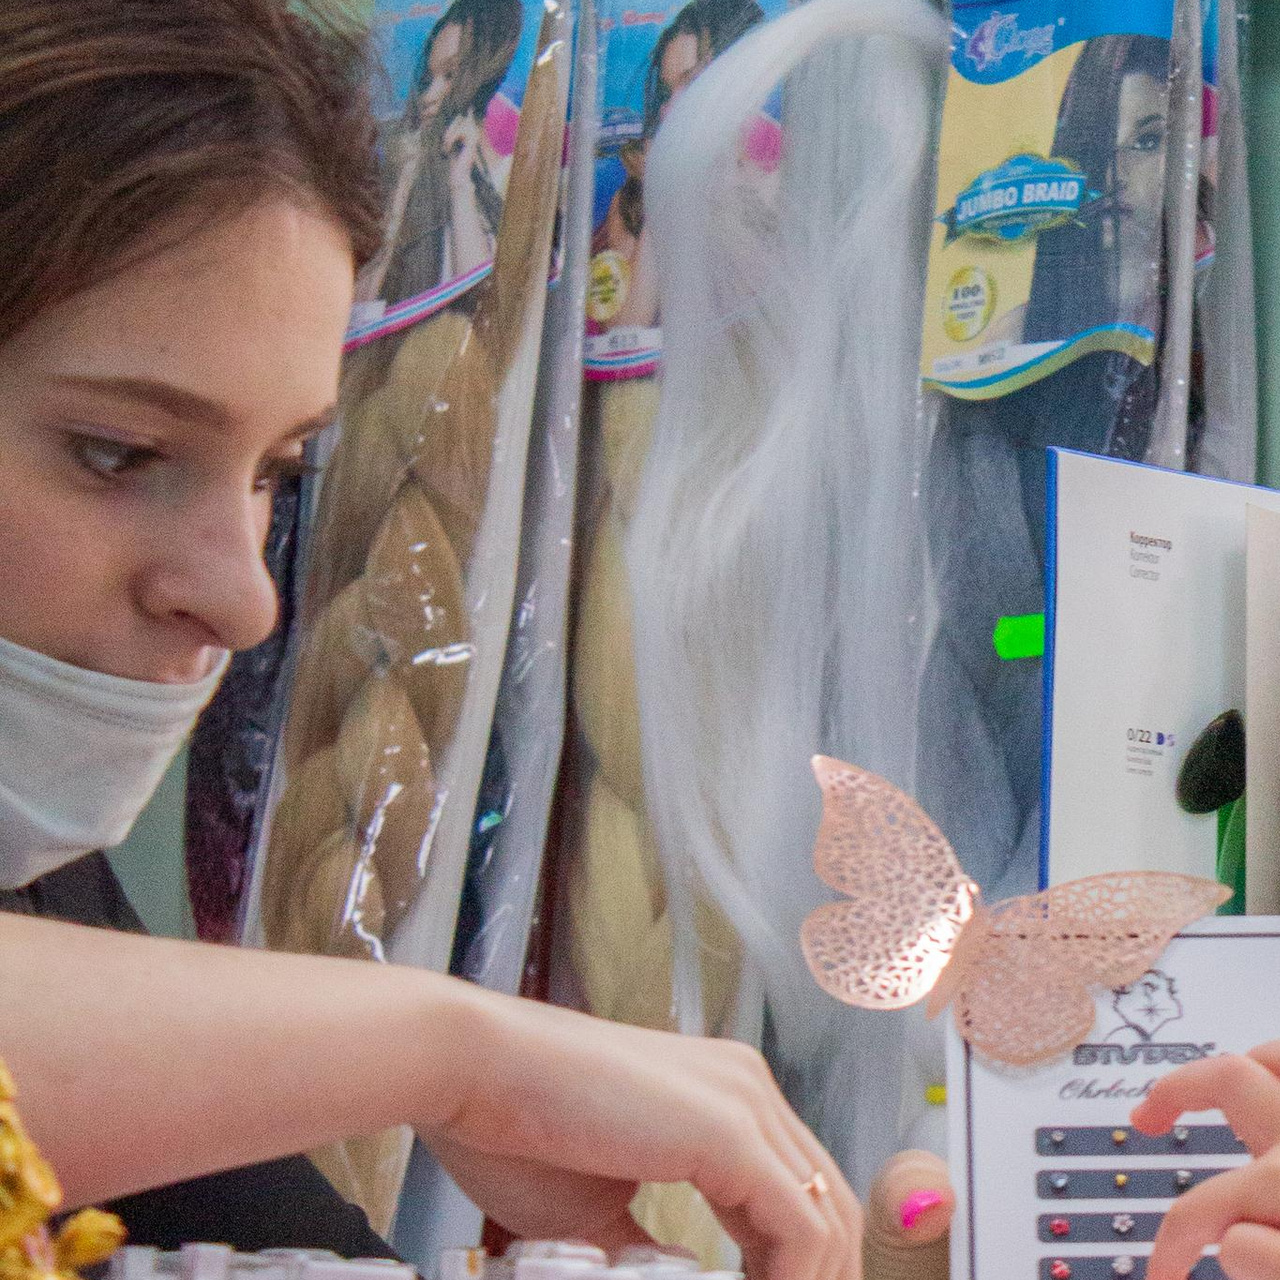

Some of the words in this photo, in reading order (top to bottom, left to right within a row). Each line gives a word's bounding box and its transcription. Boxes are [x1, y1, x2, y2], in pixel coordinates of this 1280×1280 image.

[957, 186, 1018, 220] JUMBO
[1022, 181, 1079, 204] BRAID
[1127, 728, 1151, 743] 0/22
